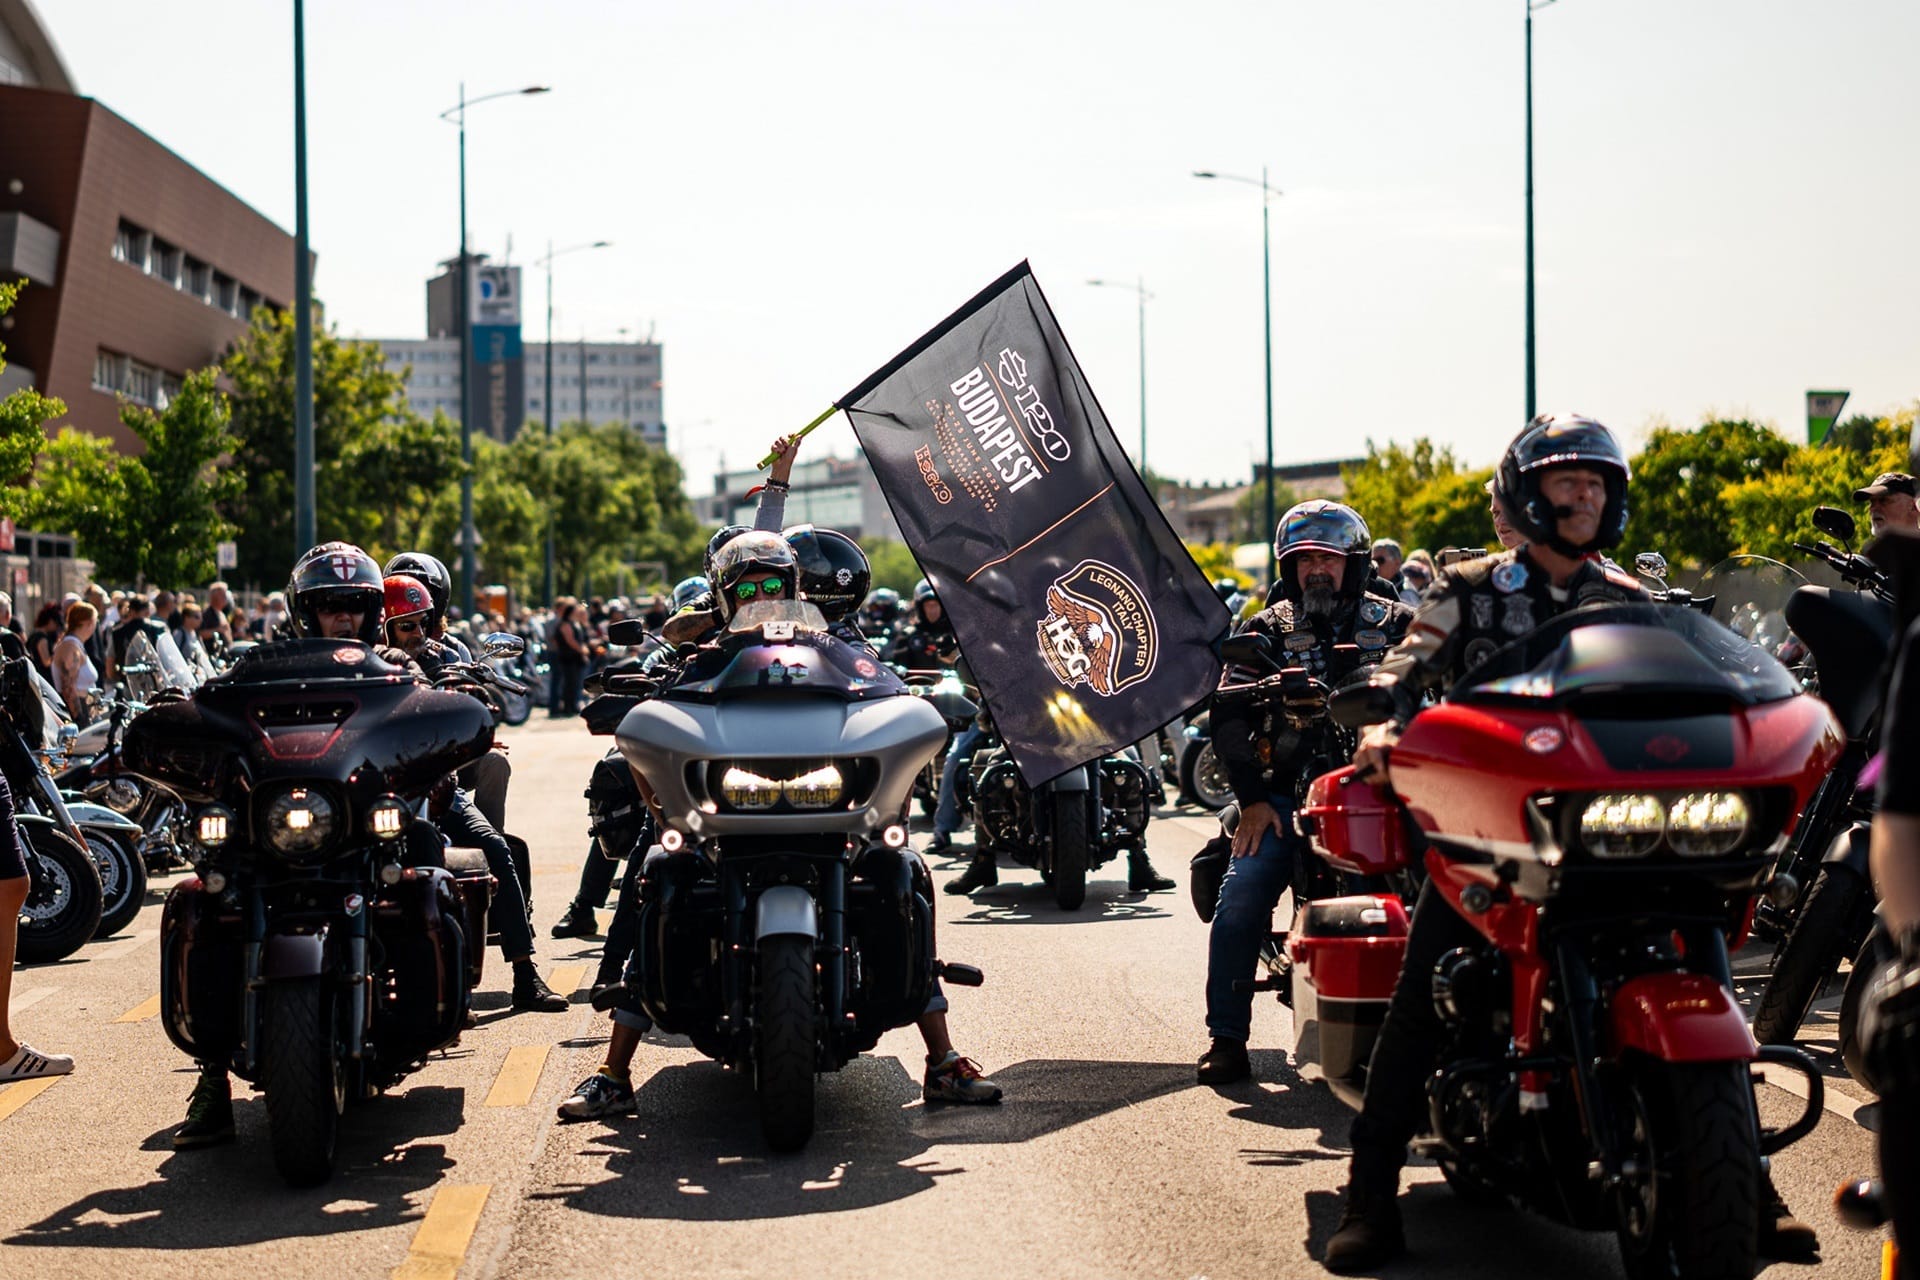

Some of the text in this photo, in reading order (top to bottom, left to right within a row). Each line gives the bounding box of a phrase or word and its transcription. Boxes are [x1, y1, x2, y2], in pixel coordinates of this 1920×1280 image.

[950, 366, 1043, 494] BUDAPEST
[1014, 384, 1071, 461] 120
[963, 437, 981, 462] JUNE
[981, 466, 1000, 491] 2023
[972, 470, 998, 508] FESTIVAL
[1089, 571, 1148, 668] LEGNANO CHAPTER
[1112, 601, 1133, 630] ITALY
